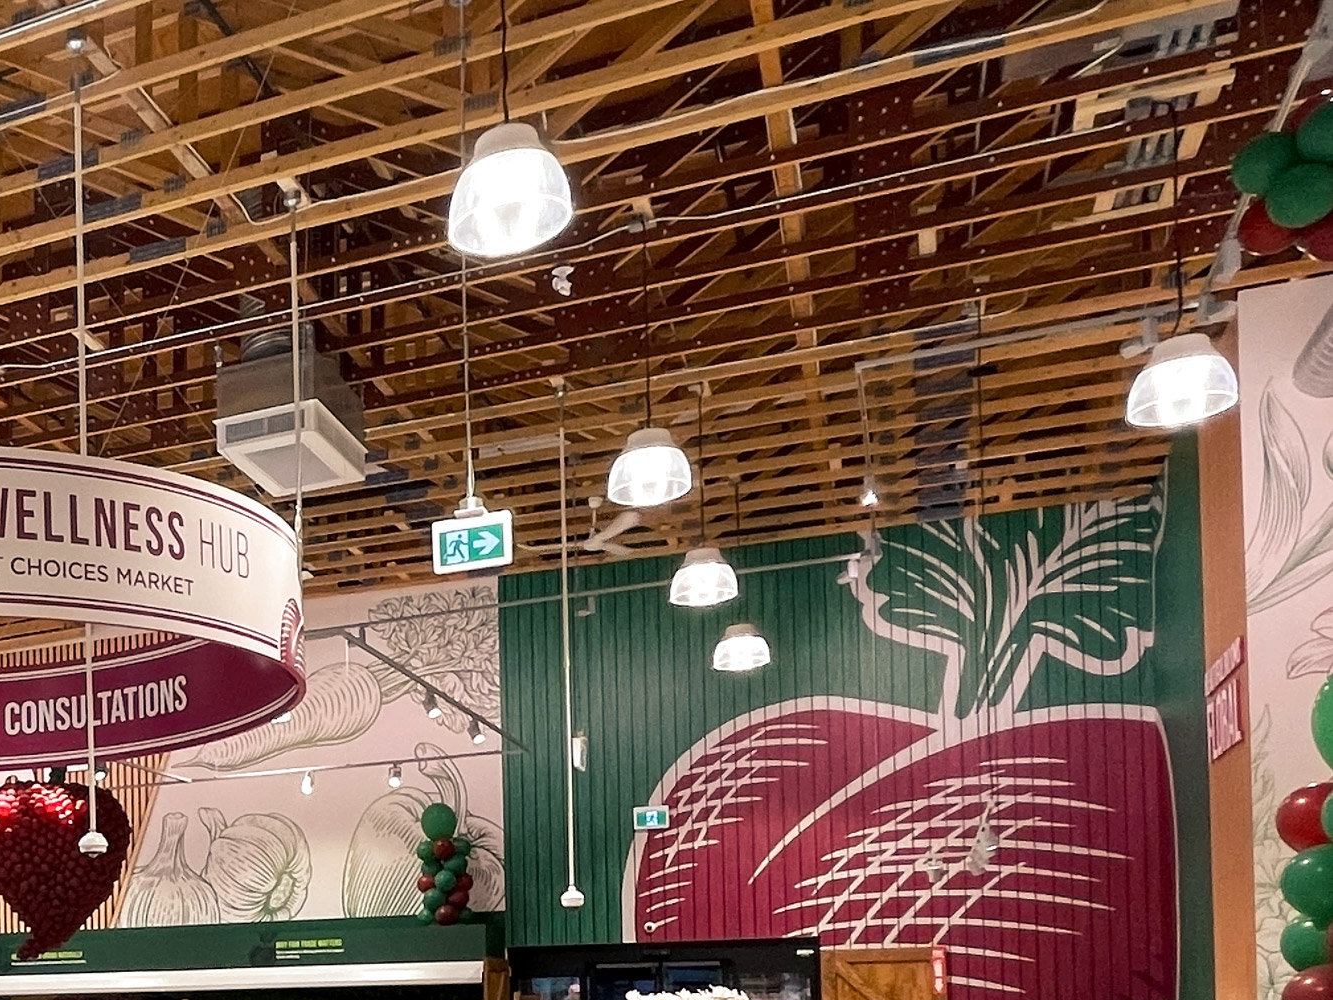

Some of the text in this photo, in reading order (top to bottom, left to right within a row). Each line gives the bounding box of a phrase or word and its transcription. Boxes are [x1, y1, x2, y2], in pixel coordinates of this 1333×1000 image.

[199, 518, 250, 579] HUB
[10, 557, 109, 583] CHOICES
[117, 568, 194, 596] MARKET
